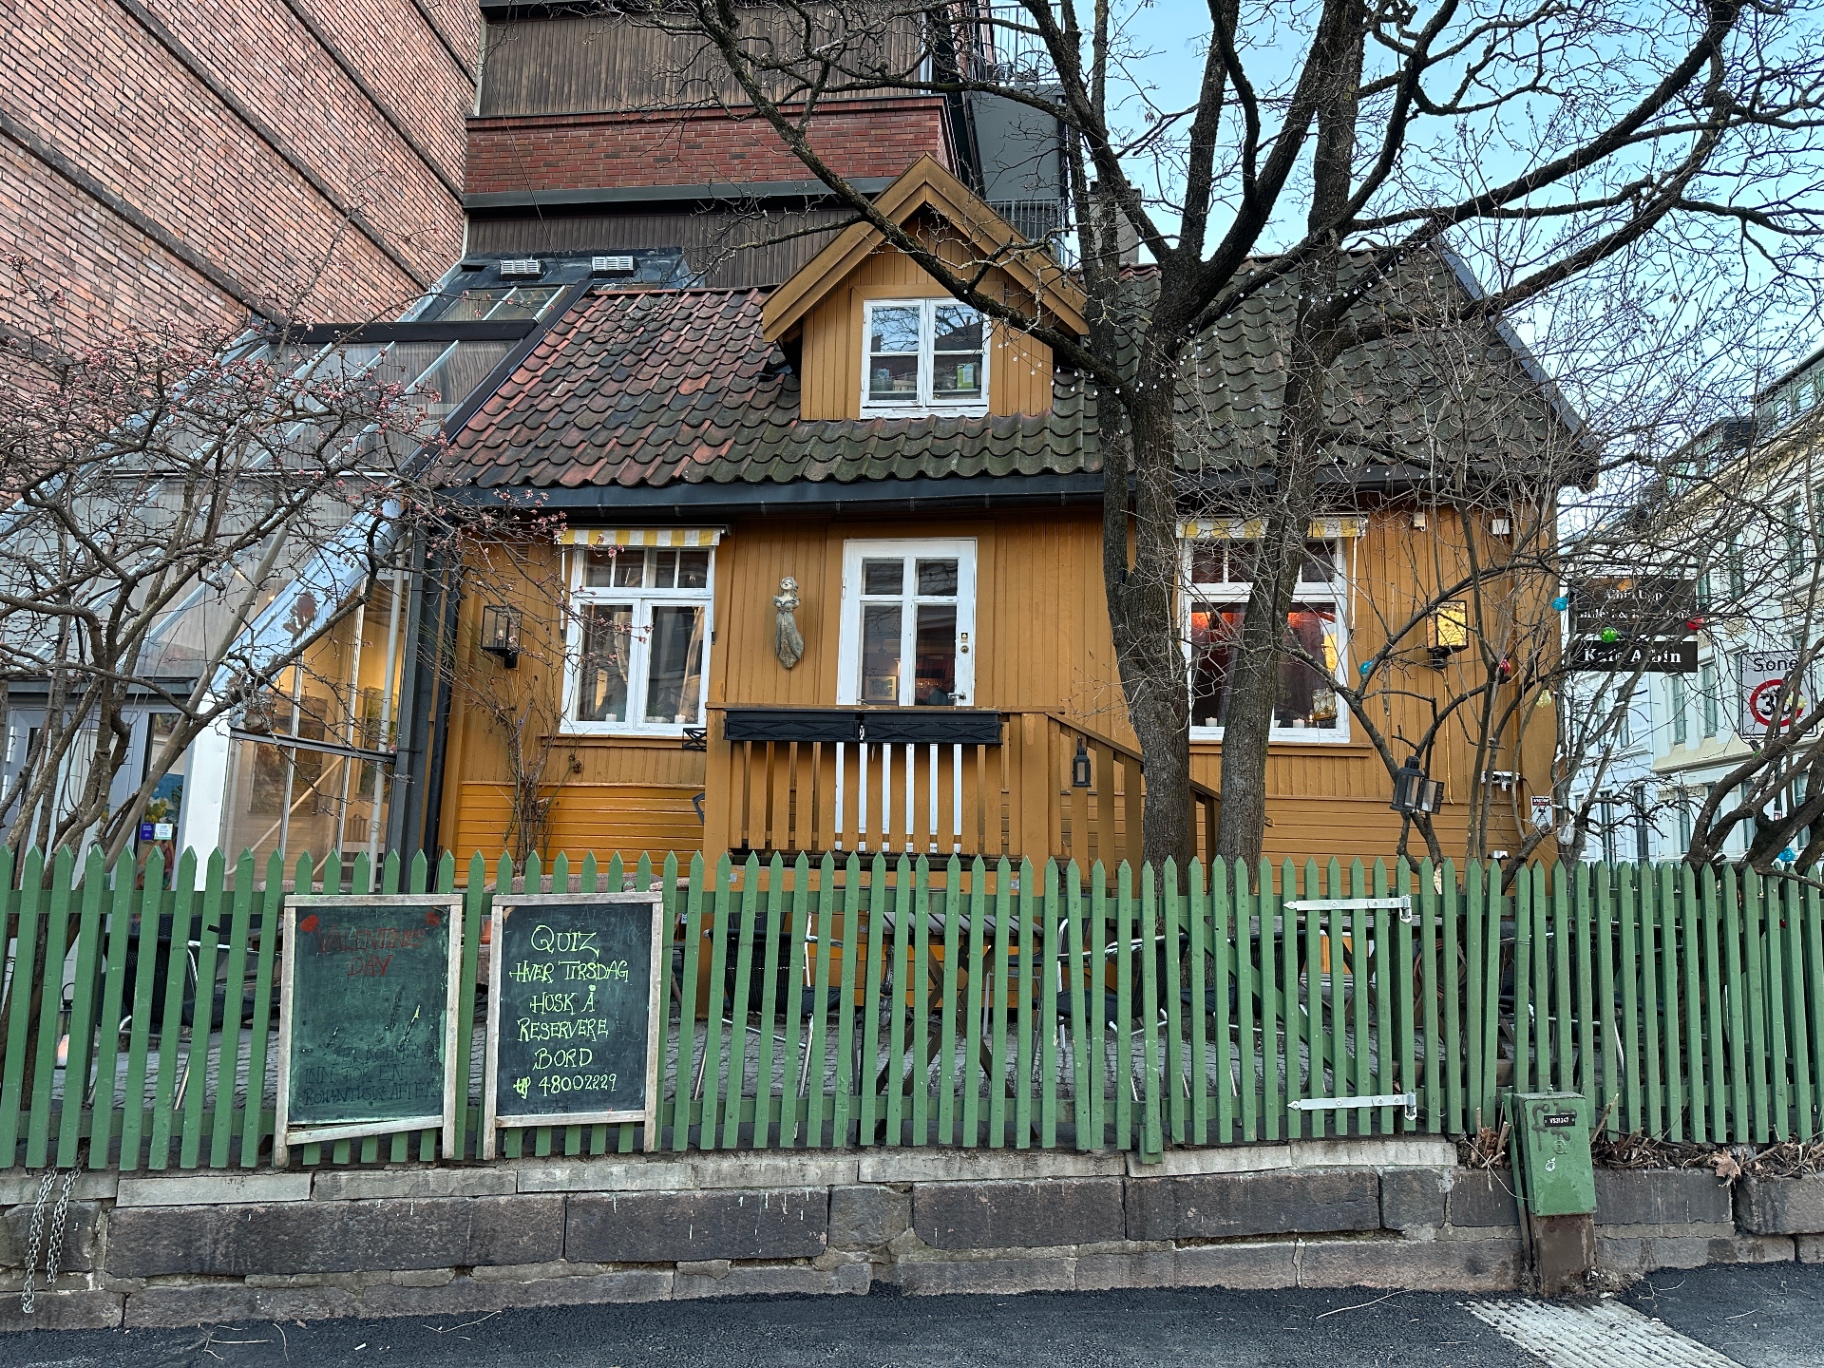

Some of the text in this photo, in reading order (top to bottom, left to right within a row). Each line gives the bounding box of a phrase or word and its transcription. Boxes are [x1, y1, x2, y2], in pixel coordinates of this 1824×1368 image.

[1630, 648, 1681, 663] Abin
[1753, 657, 1799, 672] Sone
[531, 925, 599, 957] QUIZ
[347, 954, 393, 977] DAY
[509, 959, 629, 983] HVER TIRSDAG
[530, 984, 597, 1015] HUSK Å
[517, 1017, 609, 1041] RESERVERE
[532, 1047, 593, 1071] BORD
[538, 1073, 617, 1097] 48002229
